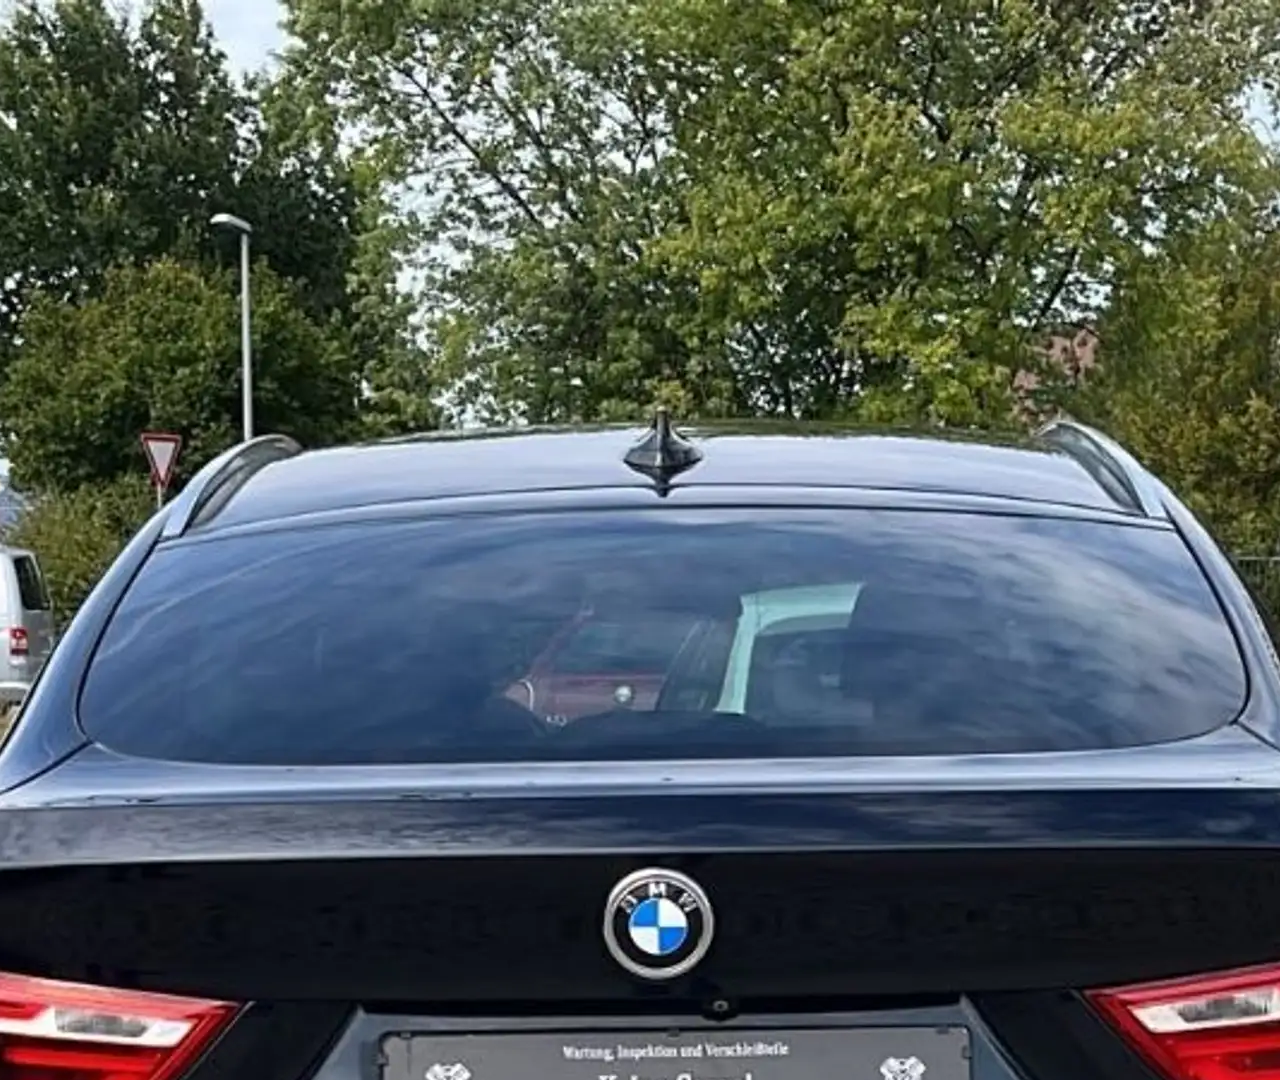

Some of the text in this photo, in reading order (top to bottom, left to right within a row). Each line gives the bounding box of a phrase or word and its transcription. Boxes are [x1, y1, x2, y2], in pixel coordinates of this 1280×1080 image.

[620, 882, 697, 913] BMW
[617, 1044, 677, 1060] Inspektion
[680, 1044, 702, 1057] und
